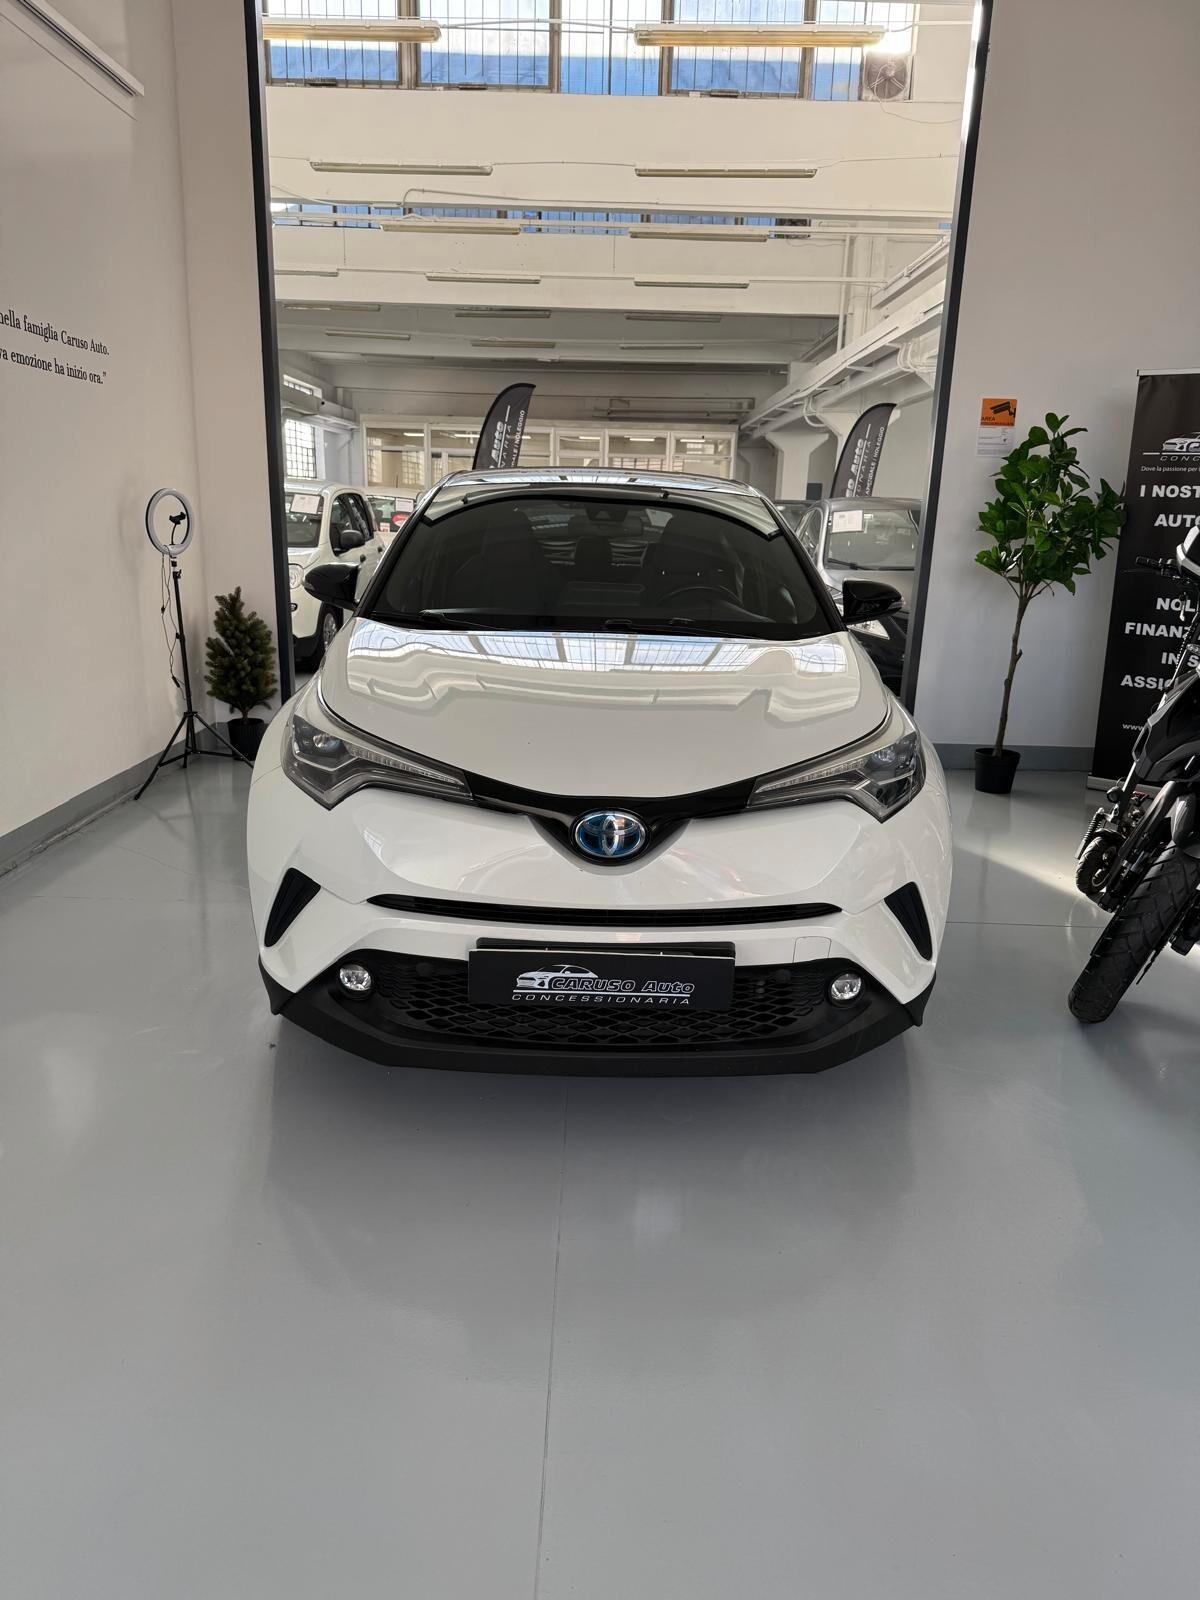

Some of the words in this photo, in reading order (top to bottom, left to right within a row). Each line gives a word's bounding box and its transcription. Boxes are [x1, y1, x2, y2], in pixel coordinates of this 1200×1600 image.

[23, 315, 59, 343] famiglia
[60, 330, 89, 351] Caruso
[90, 339, 110, 355] Auto.
[10, 351, 53, 372] emozione
[54, 358, 65, 376] ha
[66, 363, 88, 381] inizio
[515, 410, 525, 444] NOLEGGIO
[874, 426, 885, 457] NOLEGGIO
[1140, 484, 1147, 498] I
[511, 994, 691, 1005] CONCESSIONARIA
[551, 977, 636, 992] CARUSO
[641, 980, 695, 994] Auto
